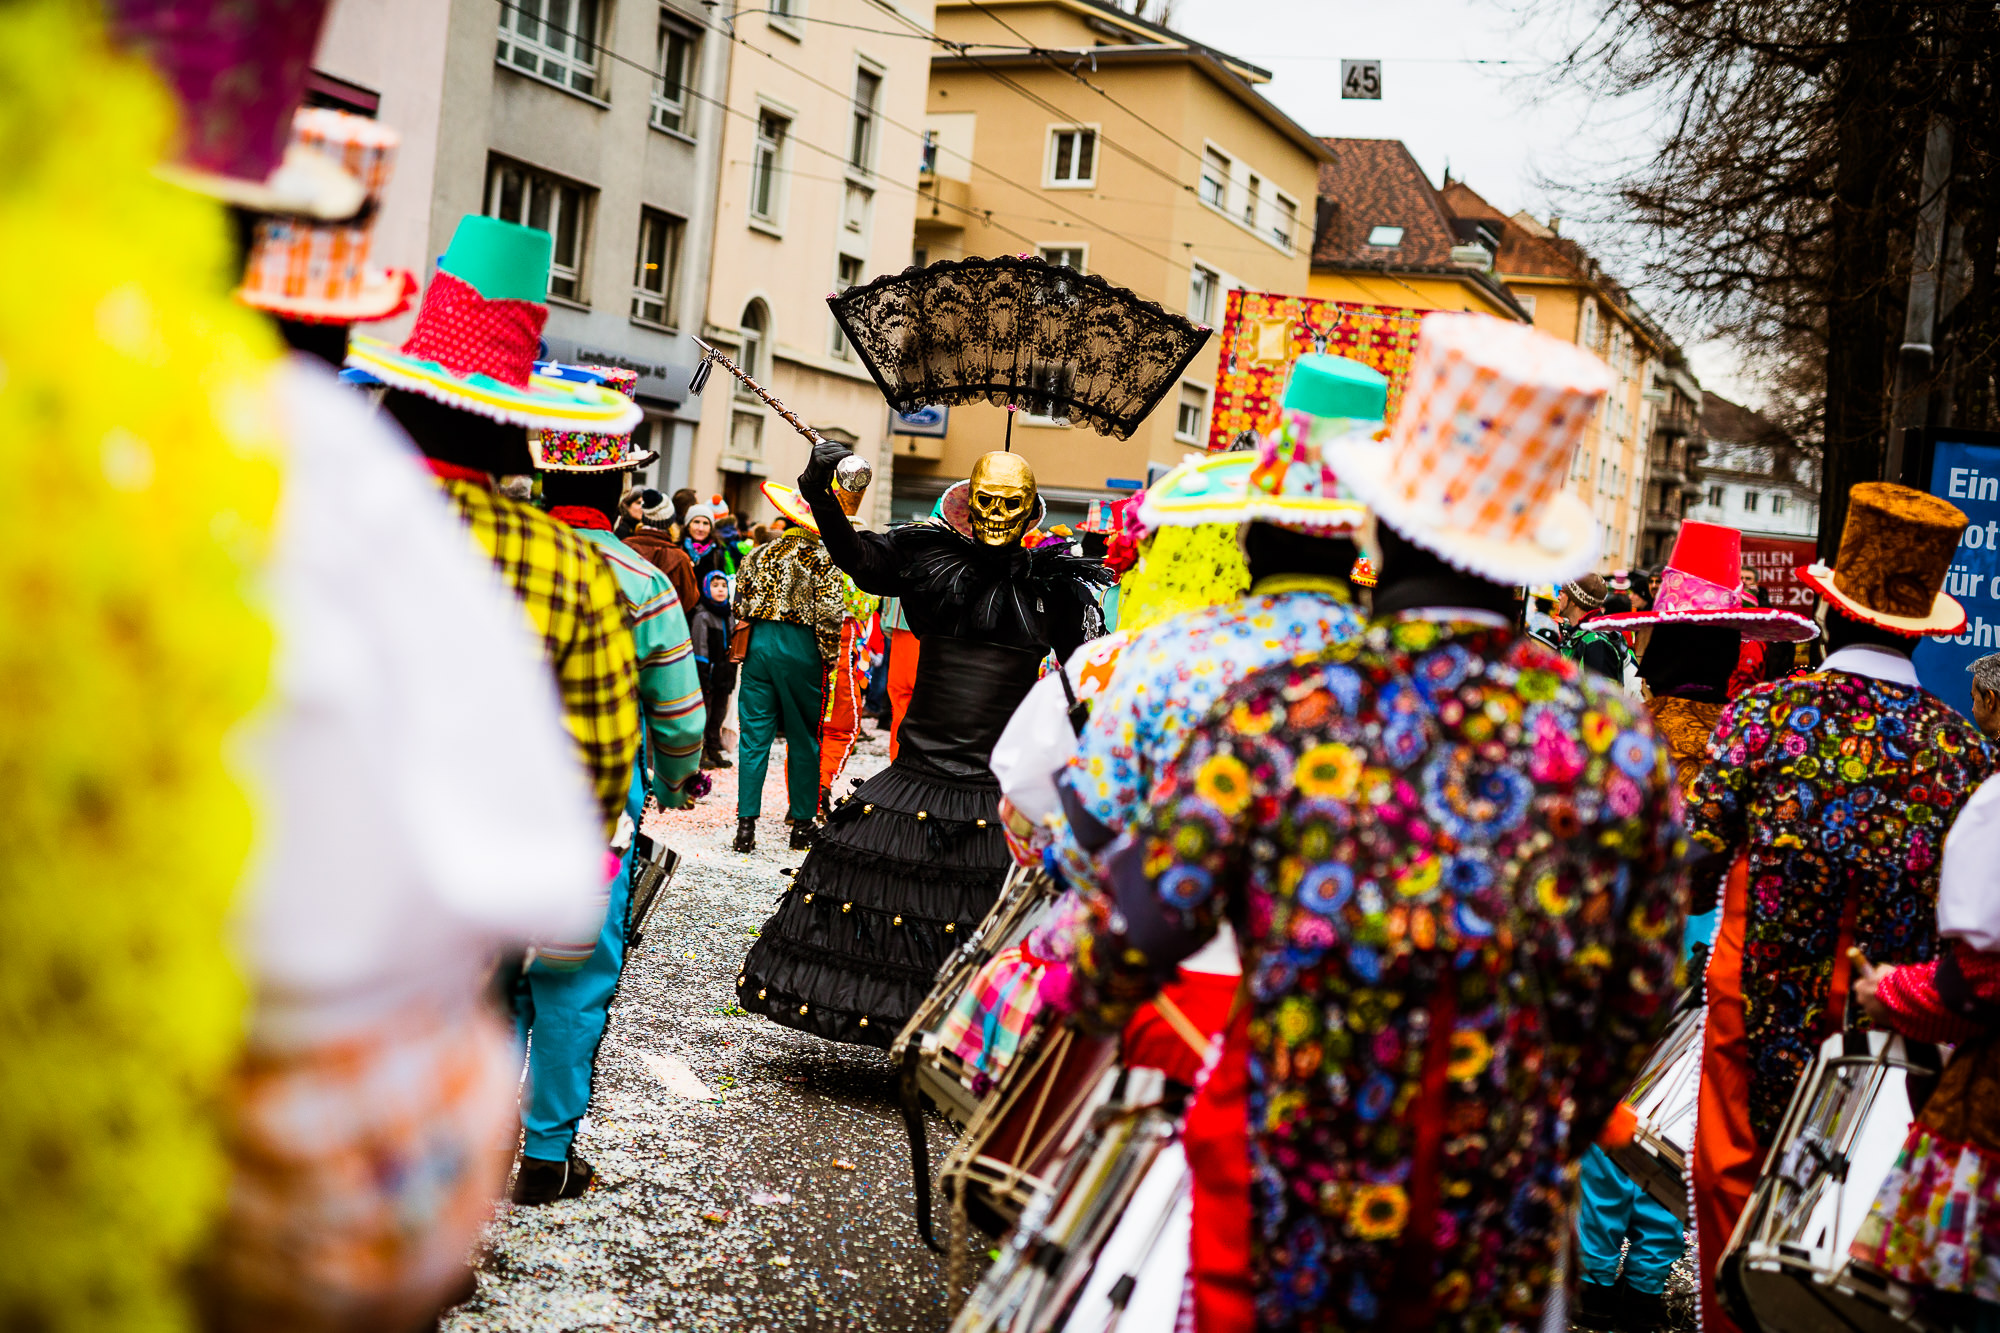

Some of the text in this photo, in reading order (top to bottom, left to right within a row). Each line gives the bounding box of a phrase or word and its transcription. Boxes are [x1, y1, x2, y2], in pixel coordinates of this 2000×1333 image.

[1346, 65, 1378, 93] 45
[1948, 467, 1999, 501] Ein
[1958, 520, 1999, 550] ot
